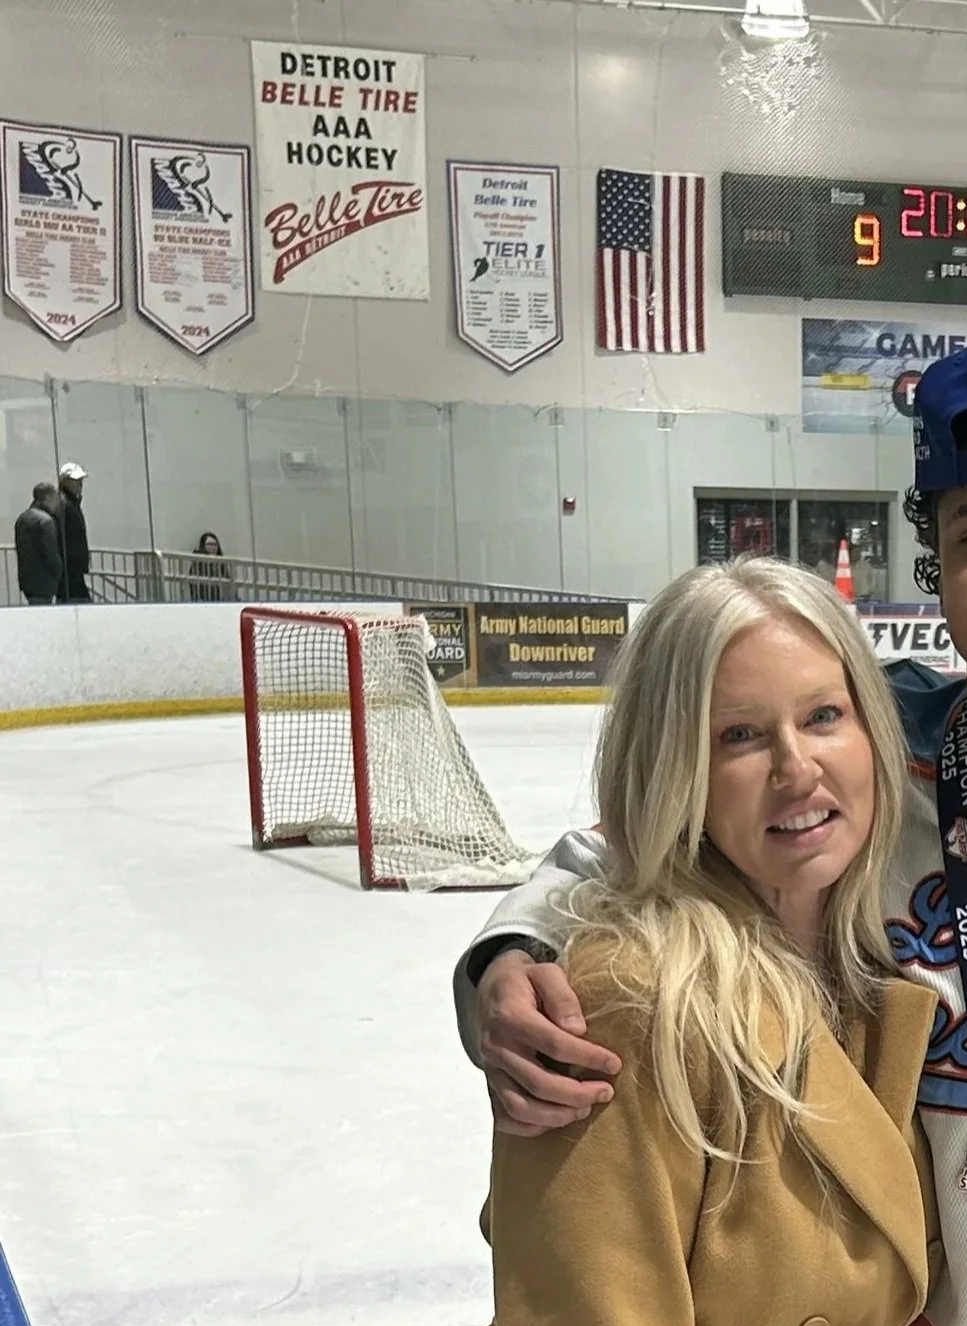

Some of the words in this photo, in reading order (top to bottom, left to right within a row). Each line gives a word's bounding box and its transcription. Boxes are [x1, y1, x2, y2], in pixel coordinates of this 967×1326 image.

[281, 52, 396, 83] DETROIT
[261, 81, 344, 108] BELLE
[359, 87, 418, 113] TIRE
[313, 114, 372, 139] AAA
[286, 142, 398, 171] HOCKEY
[482, 177, 529, 192] Detroit
[474, 194, 507, 208] Belle
[512, 196, 537, 209] Tire
[265, 190, 361, 250] Belle
[351, 181, 424, 226] Tire
[854, 214, 881, 266] 9
[483, 241, 528, 258] TIER
[534, 244, 546, 260] 1
[491, 258, 547, 272] ELITE
[46, 311, 77, 326] 2024
[180, 325, 210, 337] 2024
[428, 623, 463, 637] RMY
[479, 615, 517, 636] Army
[519, 615, 579, 635] National
[581, 616, 625, 636] Guard
[427, 646, 465, 660] UARD
[508, 643, 596, 663] Downriver
